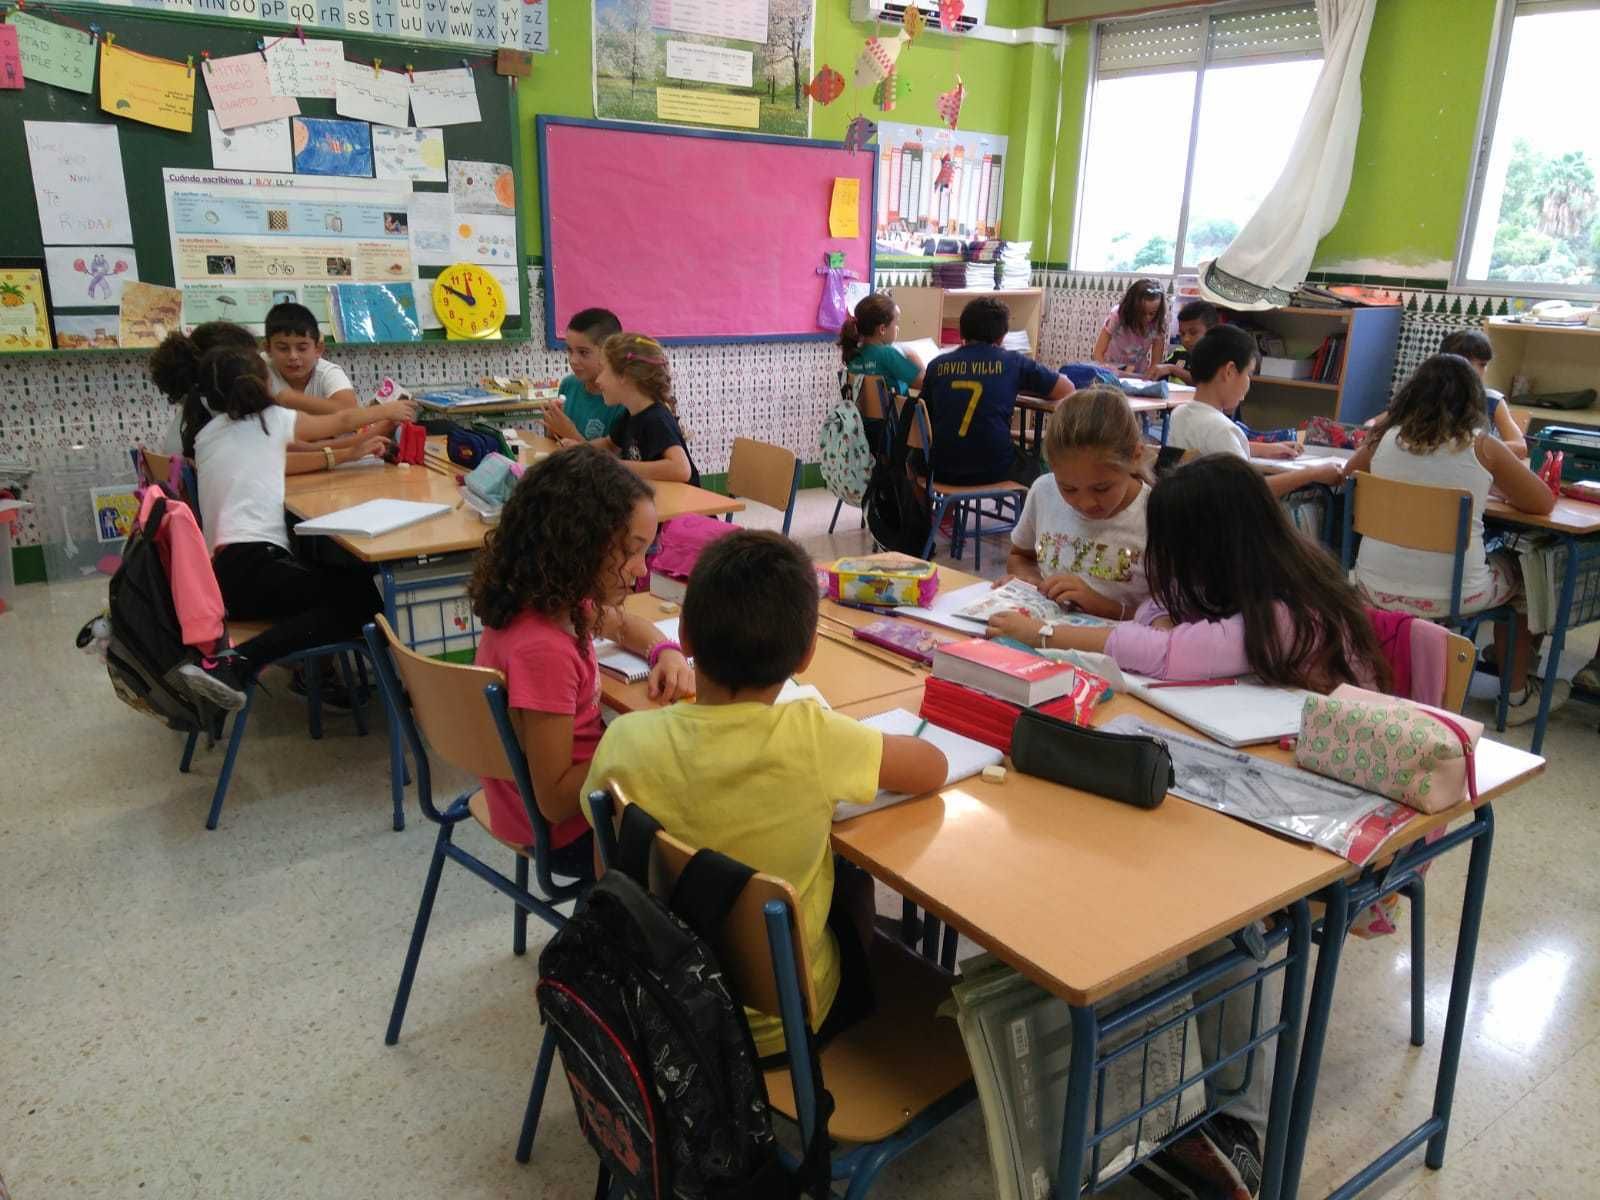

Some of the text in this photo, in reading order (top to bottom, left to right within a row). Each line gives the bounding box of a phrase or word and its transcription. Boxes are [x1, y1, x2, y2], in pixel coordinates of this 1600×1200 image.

[18, 50, 54, 69] RIPLE
[937, 360, 1002, 376] DAVID VILLA
[951, 380, 983, 437] 7
